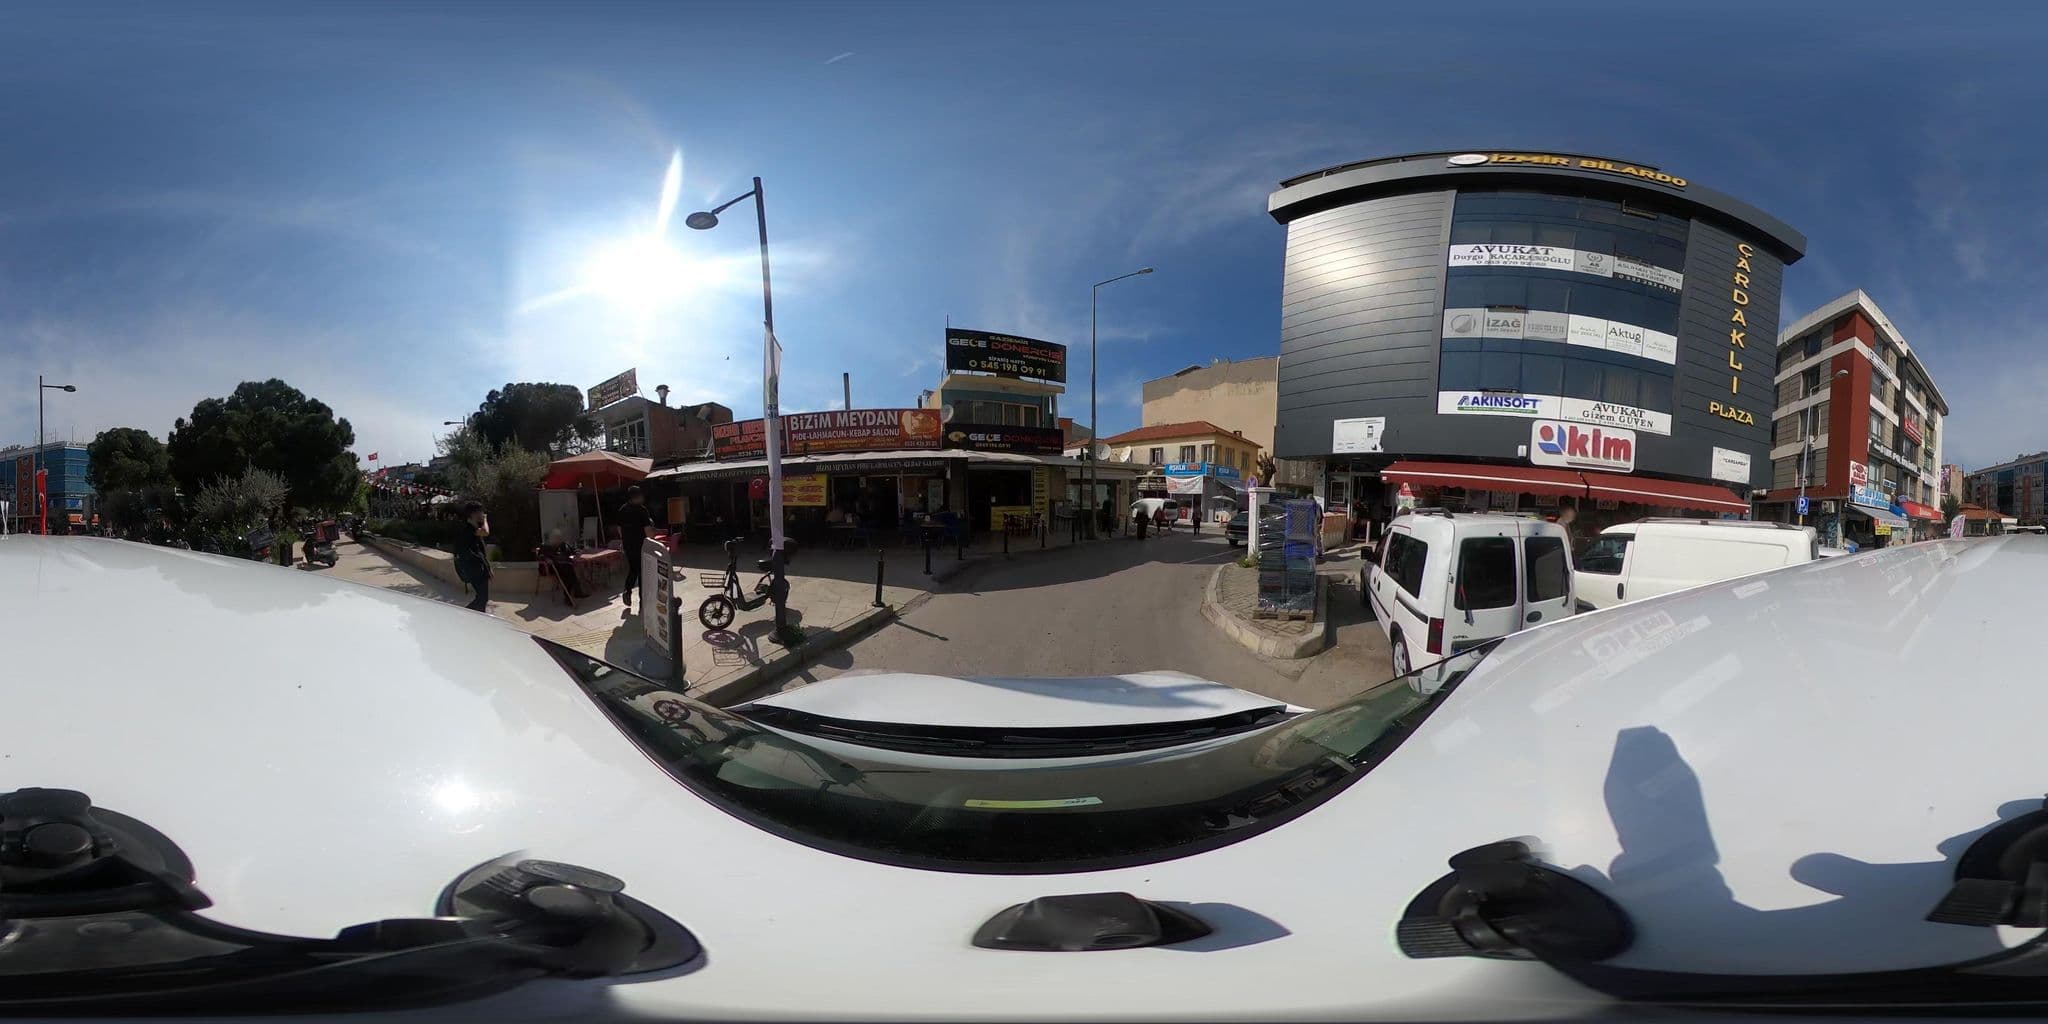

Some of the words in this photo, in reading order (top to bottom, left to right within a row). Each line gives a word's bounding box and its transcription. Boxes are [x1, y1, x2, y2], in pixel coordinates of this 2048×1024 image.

[1492, 153, 1570, 167] İZMİR
[1579, 158, 1688, 188] BİLARDO
[1470, 245, 1554, 256] AVUKAT
[949, 338, 987, 348] GECE
[981, 360, 999, 370] 545
[1003, 362, 1018, 372] 198
[1037, 368, 1046, 377] 91
[1471, 395, 1541, 409] AKINSOFT
[1582, 410, 1615, 422] Gizem
[1592, 403, 1646, 418] AVUKAT
[1709, 401, 1754, 426] PLAZA
[790, 414, 832, 431] BİZİM
[836, 411, 898, 428] MEYDAN
[872, 428, 900, 437] SALONU
[968, 433, 1001, 442] GECE
